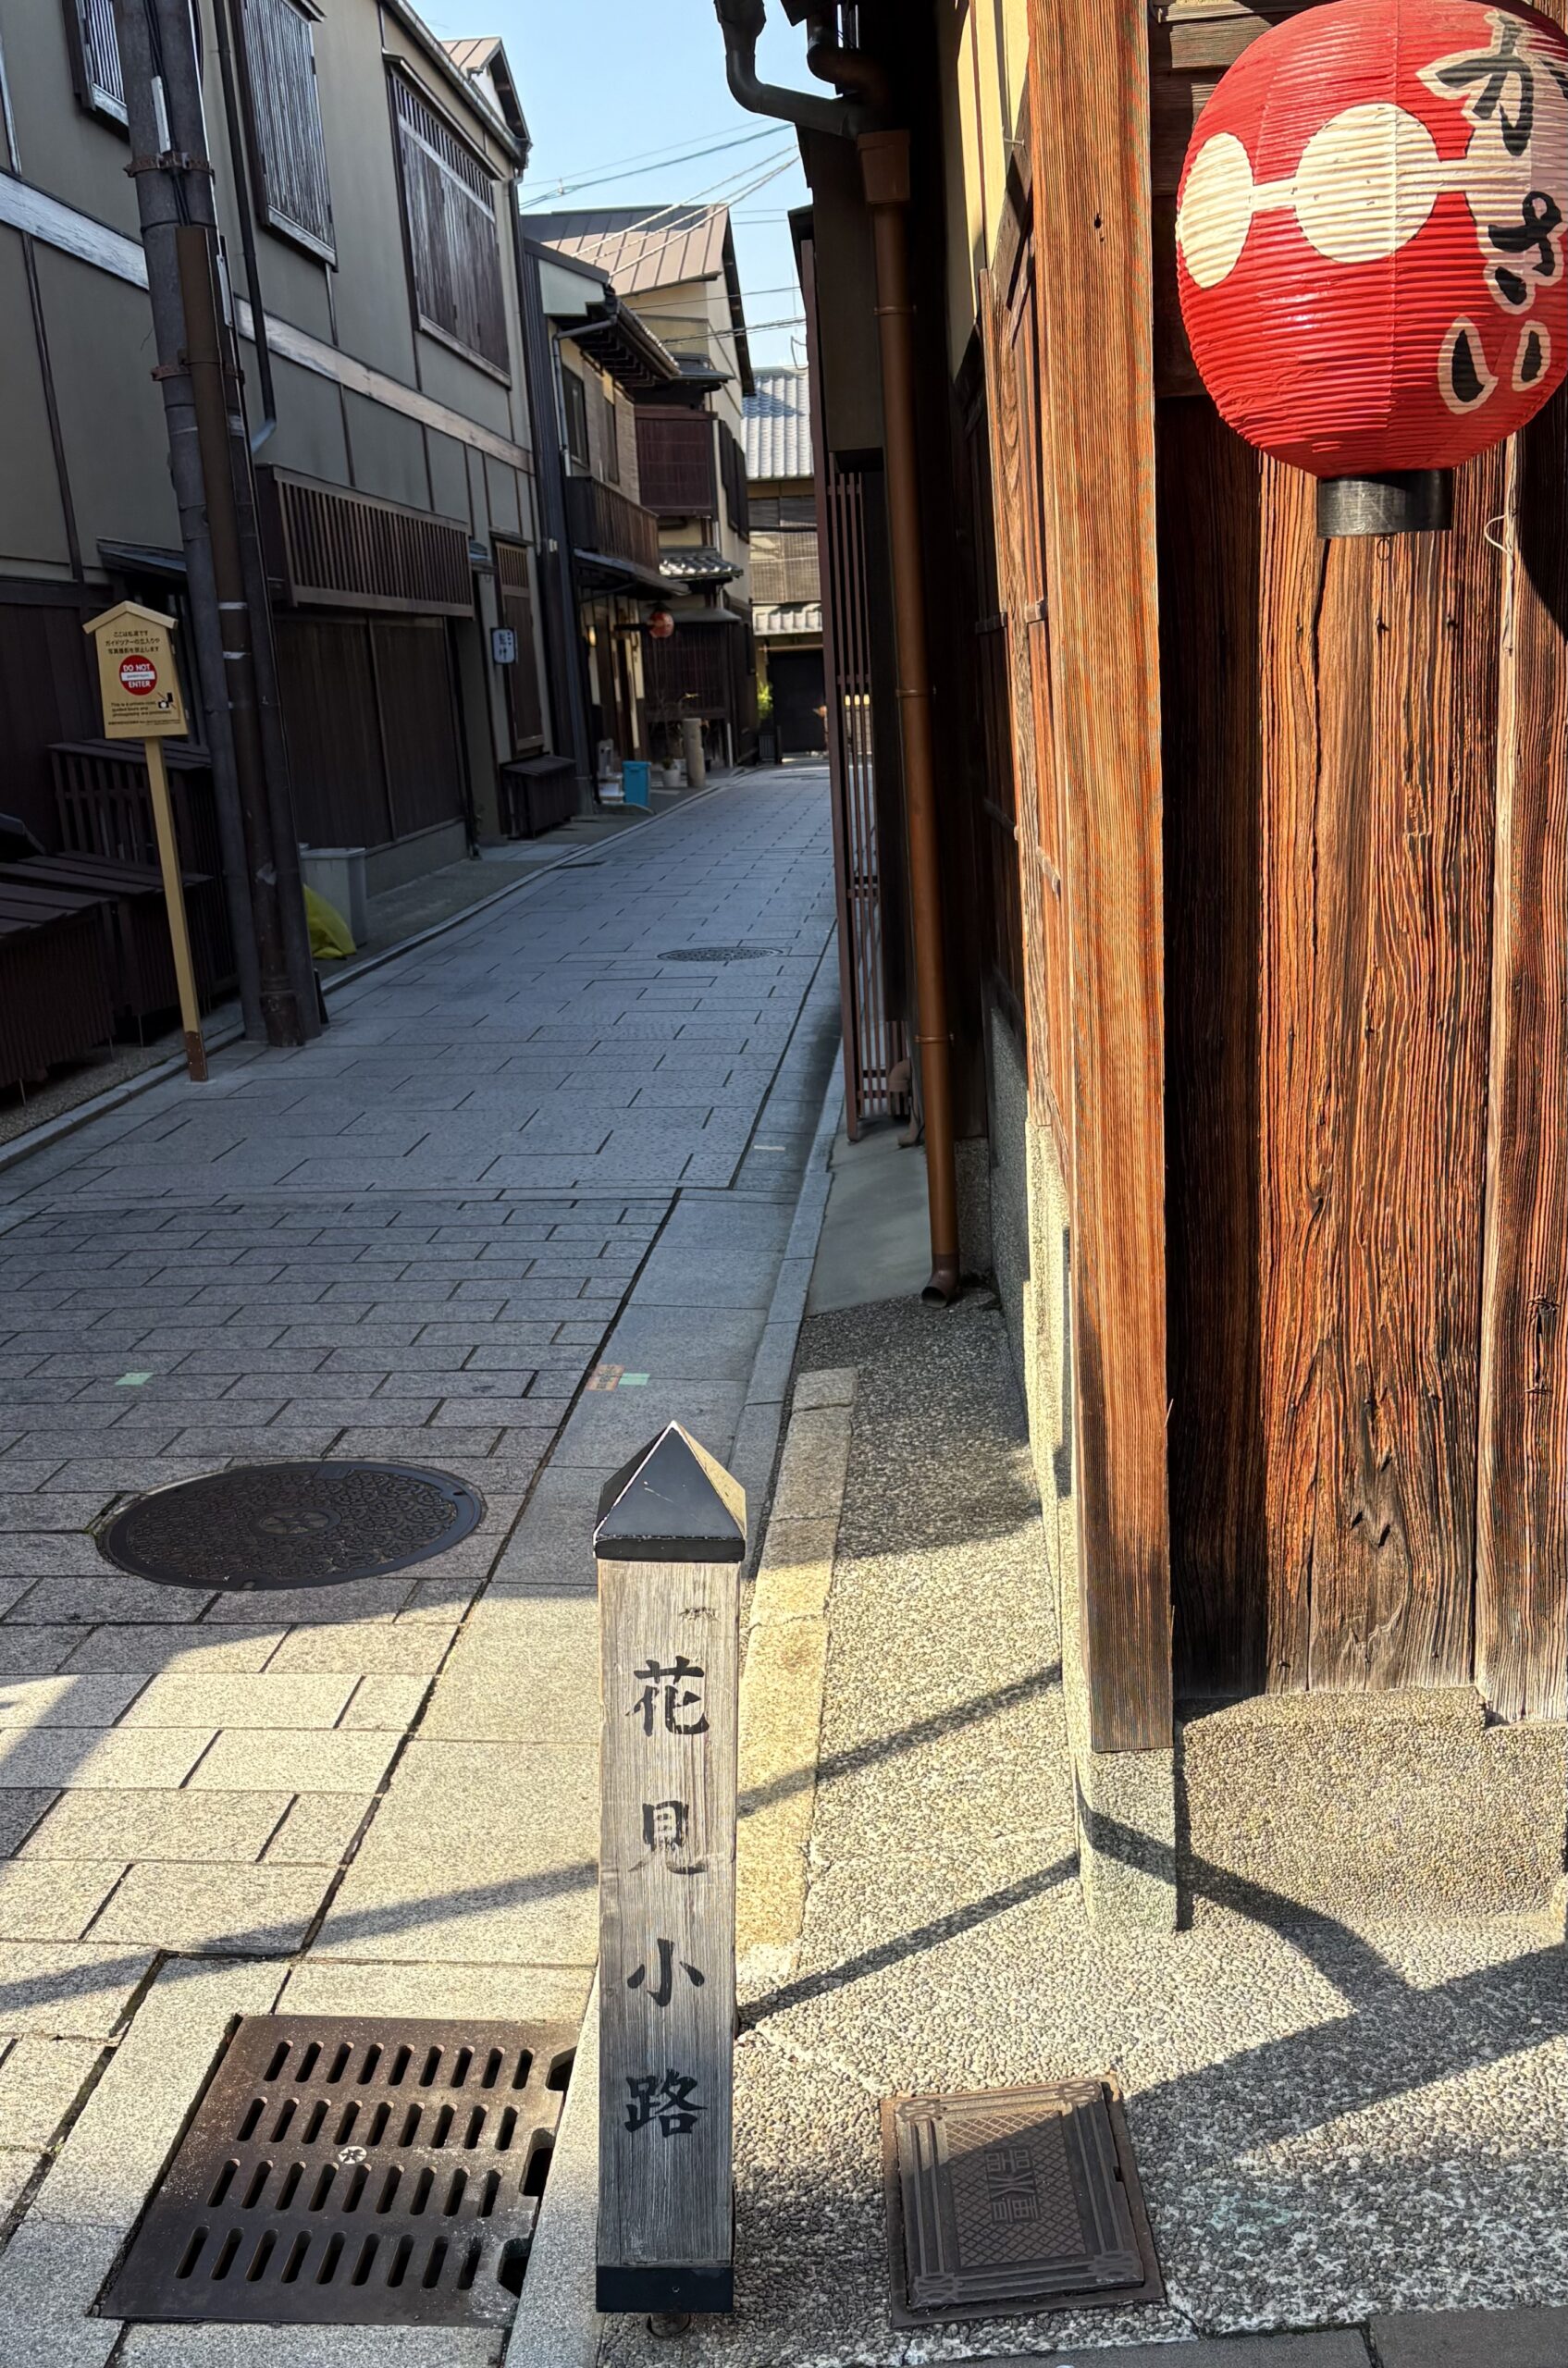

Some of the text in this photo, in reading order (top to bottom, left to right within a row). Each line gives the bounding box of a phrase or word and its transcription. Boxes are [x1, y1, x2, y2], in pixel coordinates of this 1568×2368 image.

[129, 680, 151, 688] ENTER
[135, 663, 150, 672] NOT
[624, 1655, 710, 2139] 花見小路
[985, 2147, 1040, 2224] 量水器
